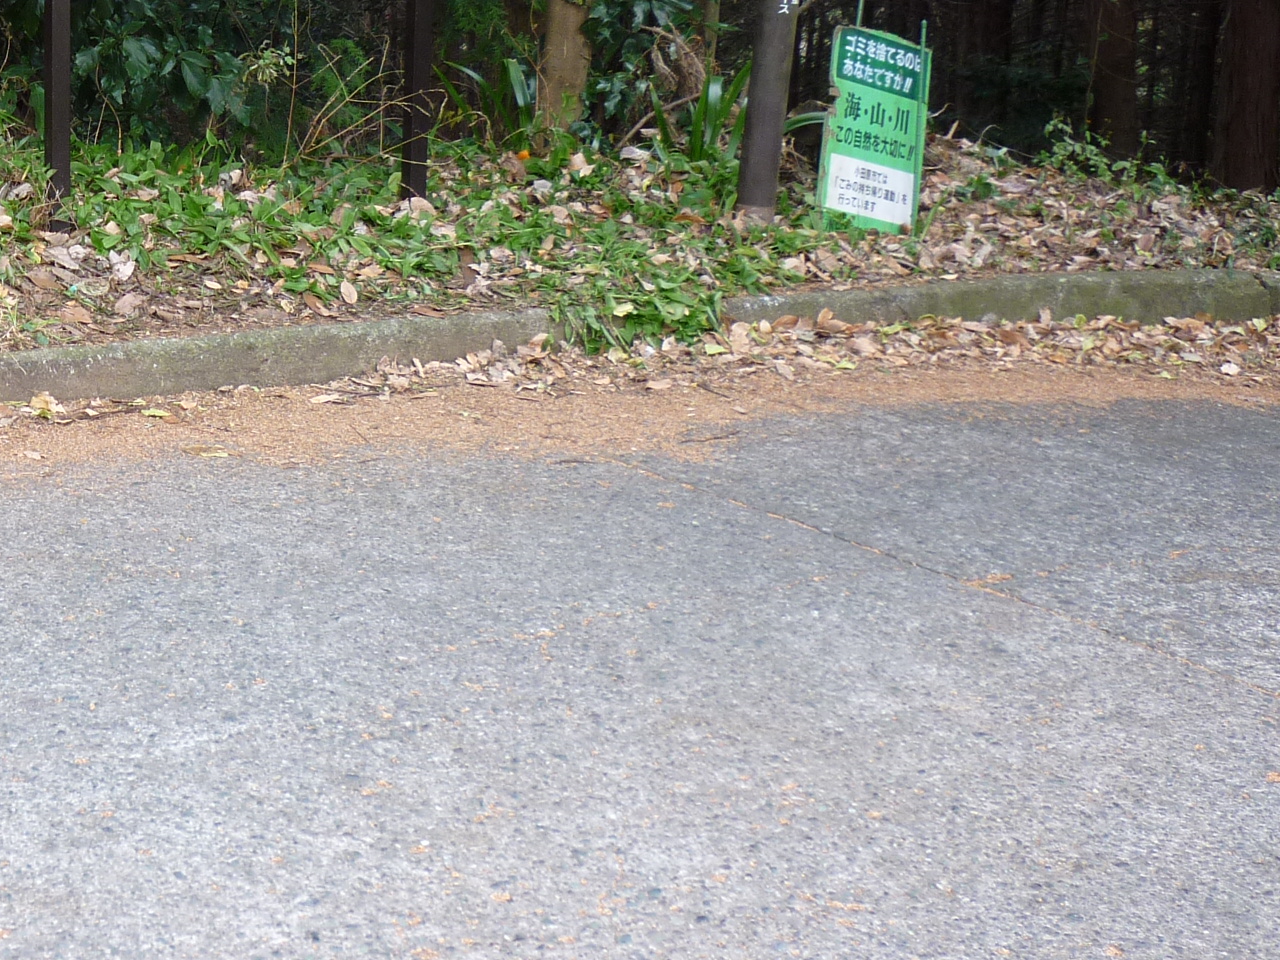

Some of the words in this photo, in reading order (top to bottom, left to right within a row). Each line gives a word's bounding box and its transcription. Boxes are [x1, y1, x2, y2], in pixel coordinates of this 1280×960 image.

[838, 193, 877, 212] 行っています
